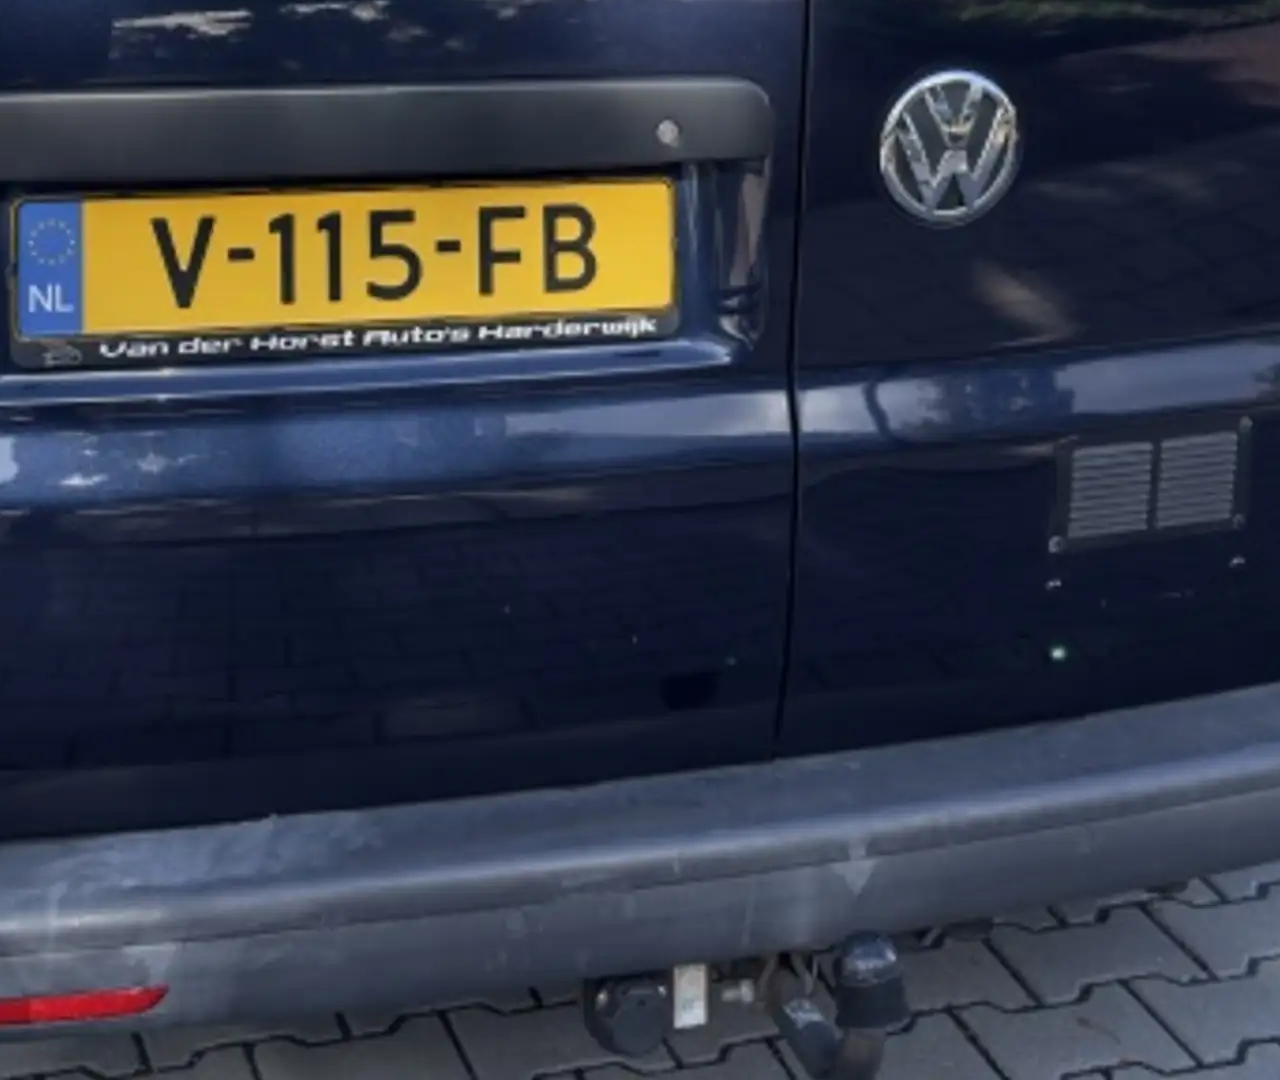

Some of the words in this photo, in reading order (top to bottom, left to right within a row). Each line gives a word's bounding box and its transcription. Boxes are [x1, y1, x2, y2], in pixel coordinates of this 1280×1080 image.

[27, 284, 74, 313] NL
[150, 204, 598, 309] V-115-FB
[99, 338, 169, 359] Van
[177, 336, 243, 355] der
[249, 329, 355, 351] Horst
[362, 325, 469, 347] Auto's
[478, 315, 657, 341] Harderwijk
